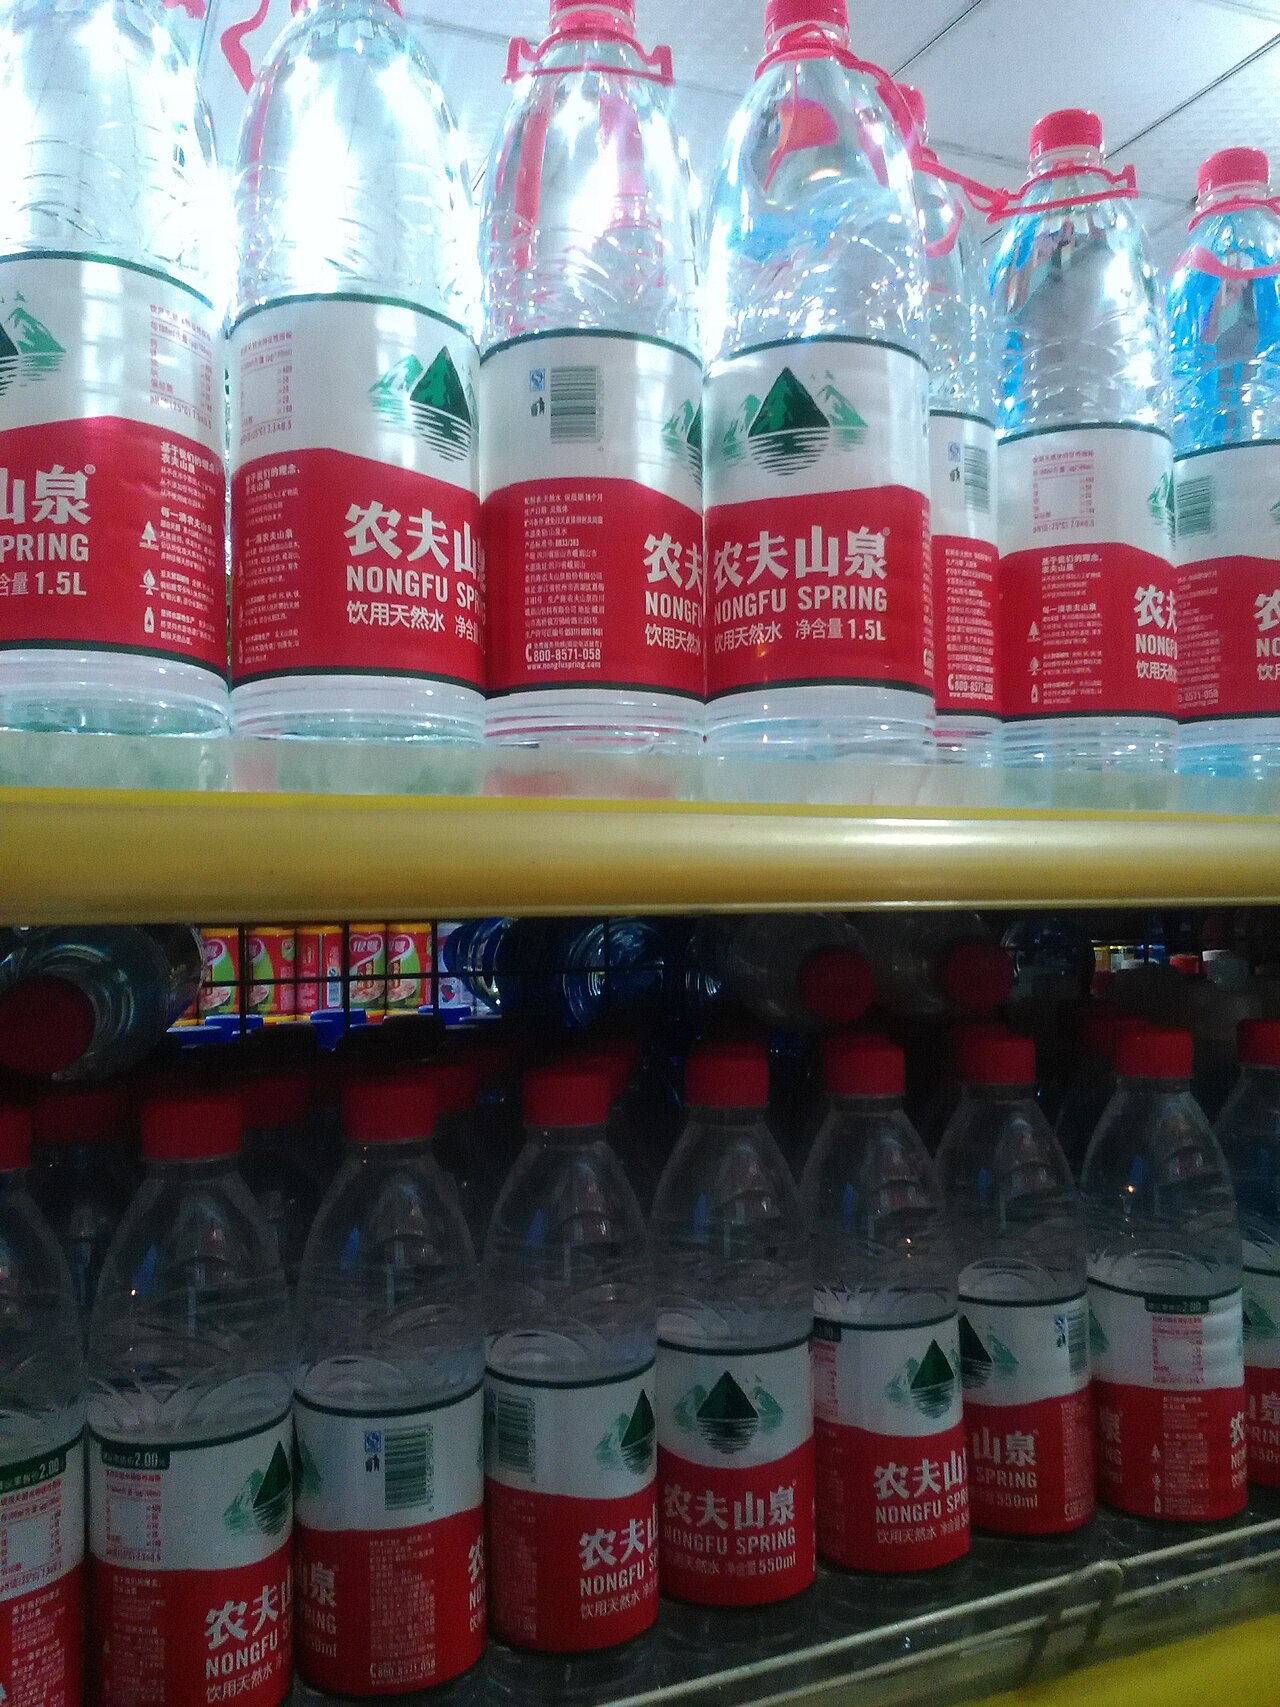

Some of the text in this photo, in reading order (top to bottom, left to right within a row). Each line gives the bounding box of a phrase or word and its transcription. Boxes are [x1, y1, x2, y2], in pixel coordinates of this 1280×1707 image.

[343, 500, 486, 592] 农夫山
[714, 525, 888, 595] 农夫山泉
[35, 571, 87, 596] 1.5L
[346, 565, 449, 603] NONGFU
[346, 600, 446, 634] 饮用天然水
[714, 584, 888, 627] NONGFU SPRING
[714, 620, 783, 654] 饮用天然水
[533, 648, 601, 662] 800-8571-058
[1257, 663, 1280, 681] 饮
[976, 1466, 1037, 1489] SPRING
[664, 1482, 796, 1532] 农夫山泉
[875, 1498, 942, 1525] NONGFU
[664, 1523, 796, 1556] NONGFU SPRING
[581, 1559, 645, 1599] NONGFU
[205, 1626, 279, 1680] NONGFU
